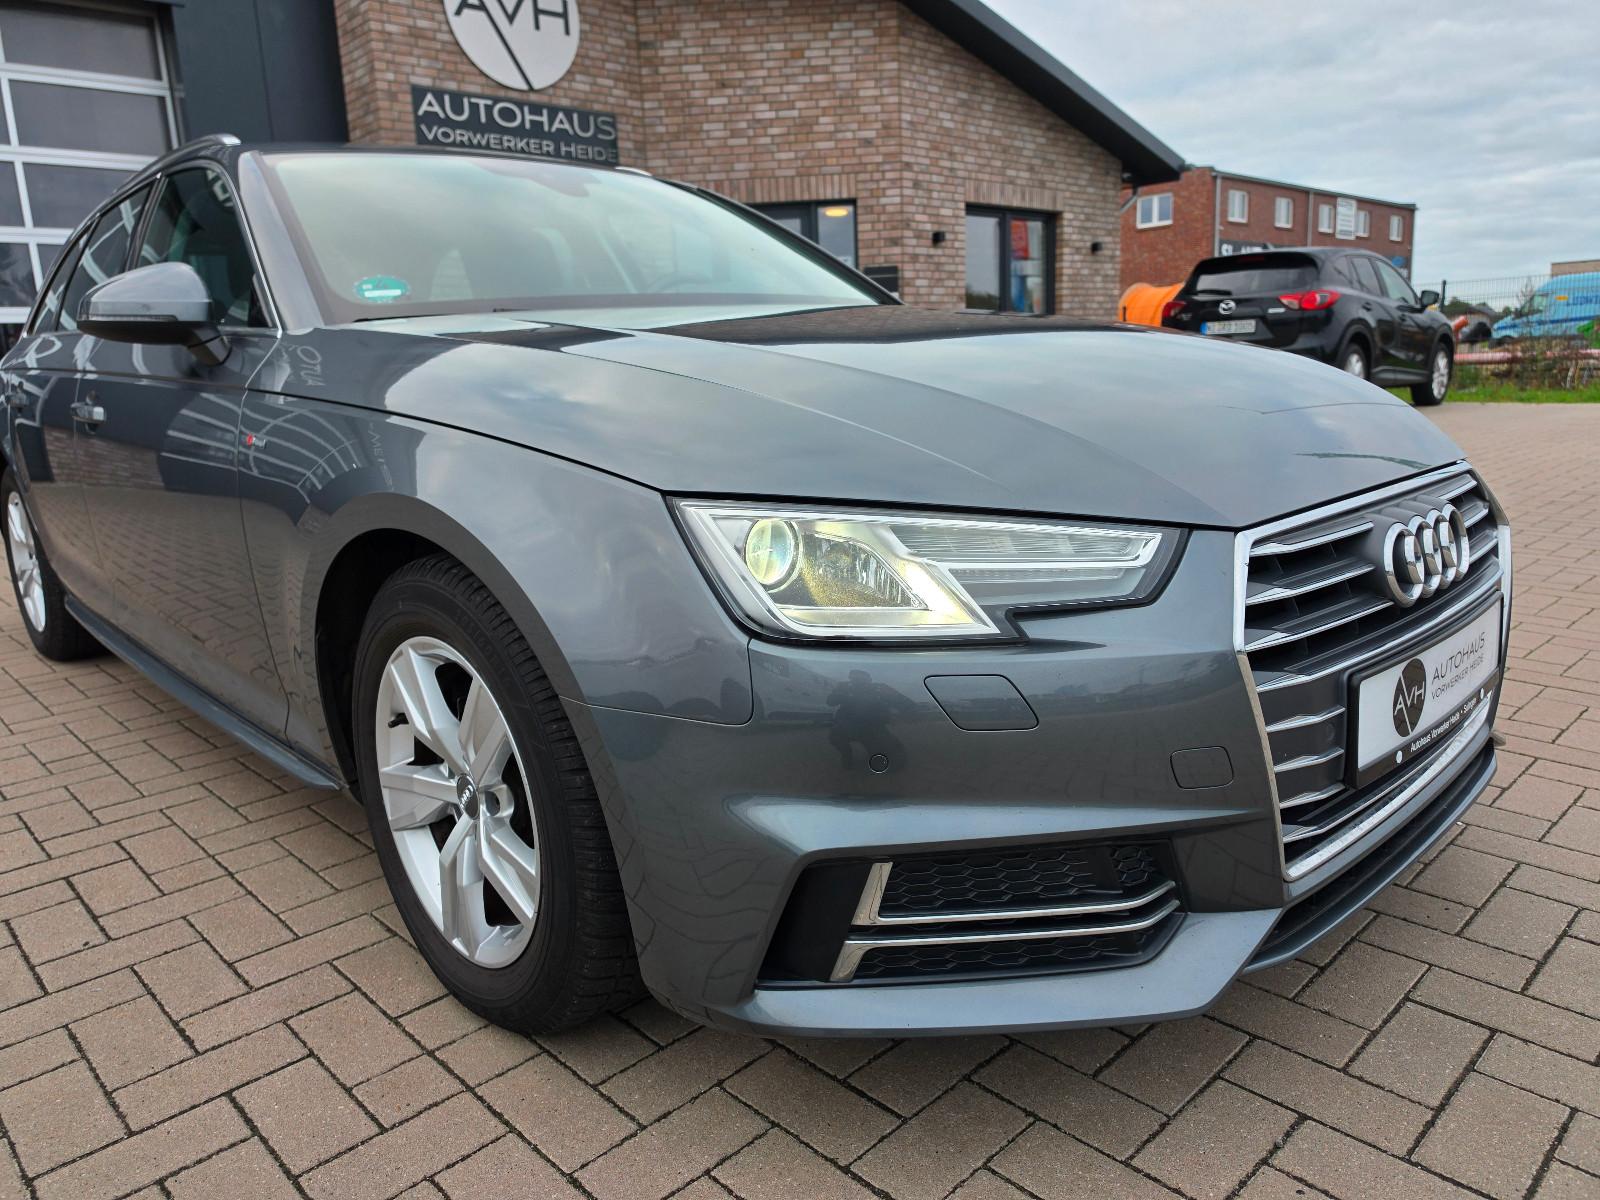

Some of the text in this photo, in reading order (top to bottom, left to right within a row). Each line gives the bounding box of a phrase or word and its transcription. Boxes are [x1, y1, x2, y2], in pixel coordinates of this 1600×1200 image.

[417, 92, 615, 140] AUTOHAUS
[420, 124, 617, 162] VORWERKER HEIDE
[1431, 632, 1485, 684] AUTOHAUS
[1394, 680, 1424, 722] AVH
